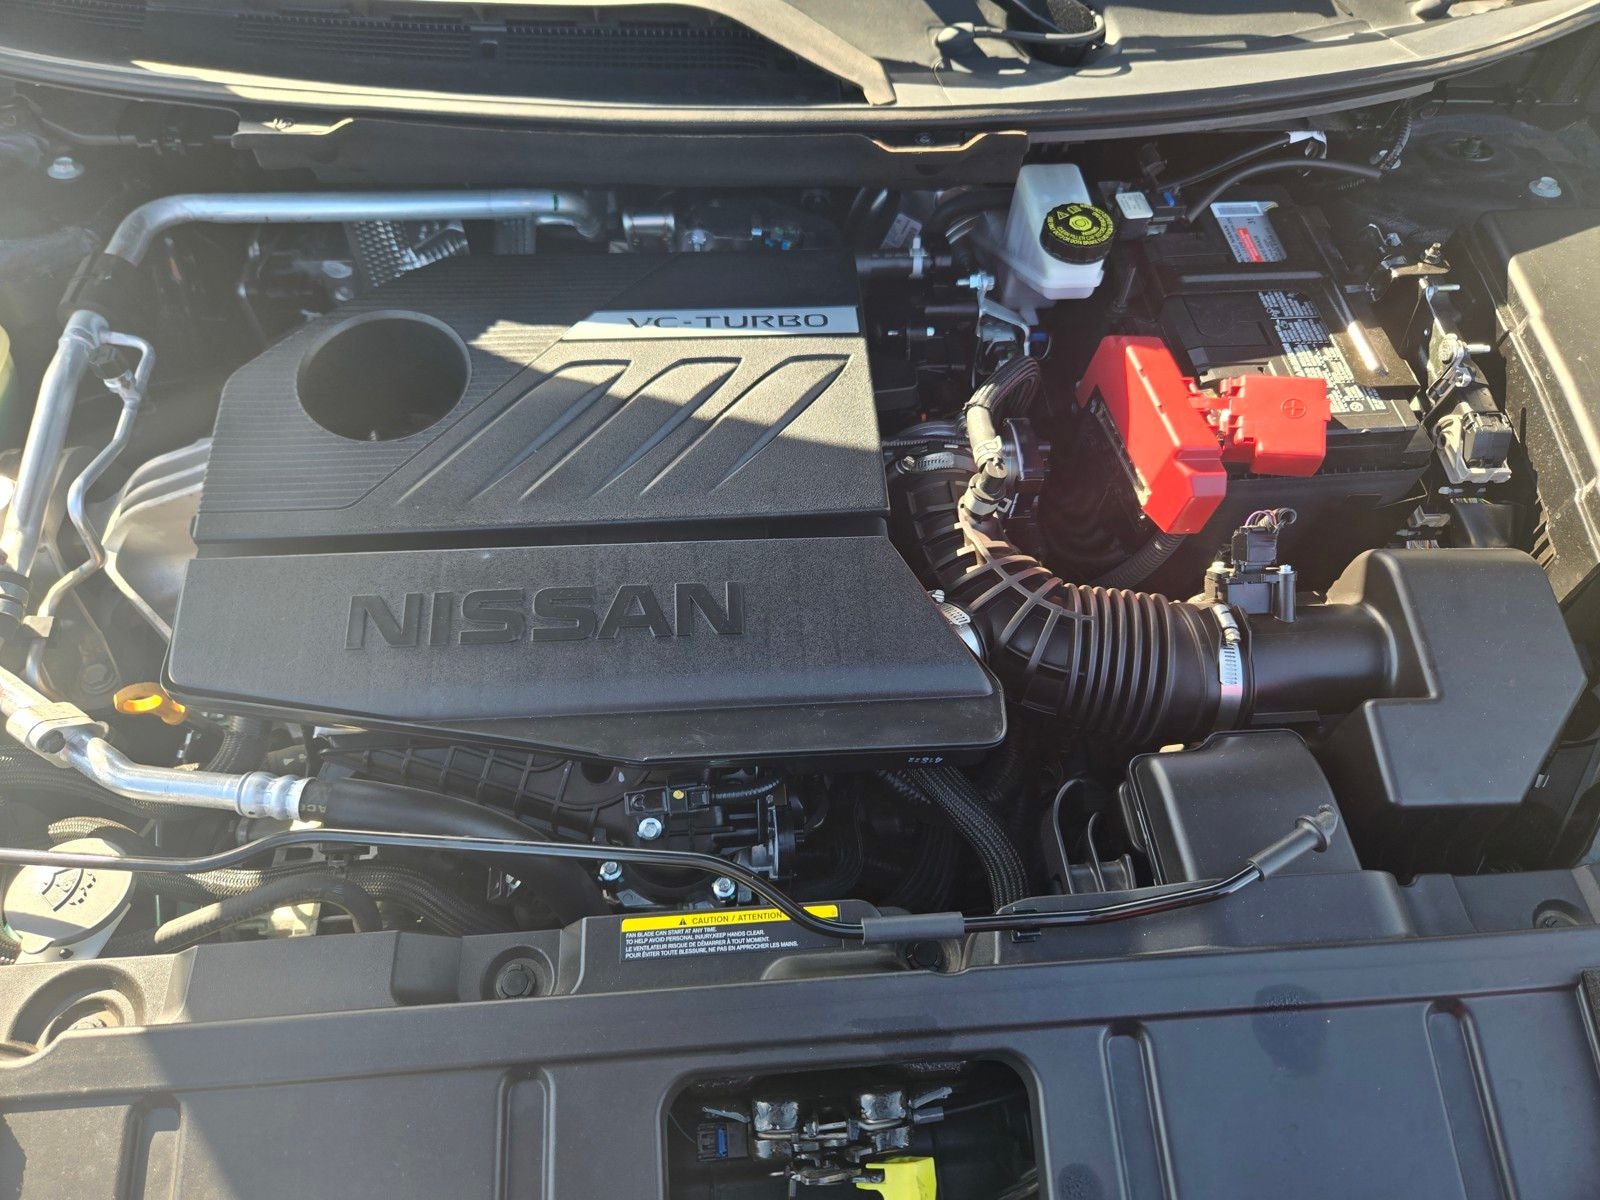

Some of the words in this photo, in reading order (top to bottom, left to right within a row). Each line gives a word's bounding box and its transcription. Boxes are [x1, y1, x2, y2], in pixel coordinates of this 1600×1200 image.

[626, 313, 829, 329] VC-TURBO
[345, 582, 744, 649] NISSAN
[692, 916, 729, 924] CAUTION
[738, 912, 782, 921] ATTENTION
[633, 944, 667, 952] VENTILATEUR
[697, 939, 726, 947] DÉMARRER
[641, 950, 660, 958] ÉVITER
[736, 943, 769, 951] APPROCHER
